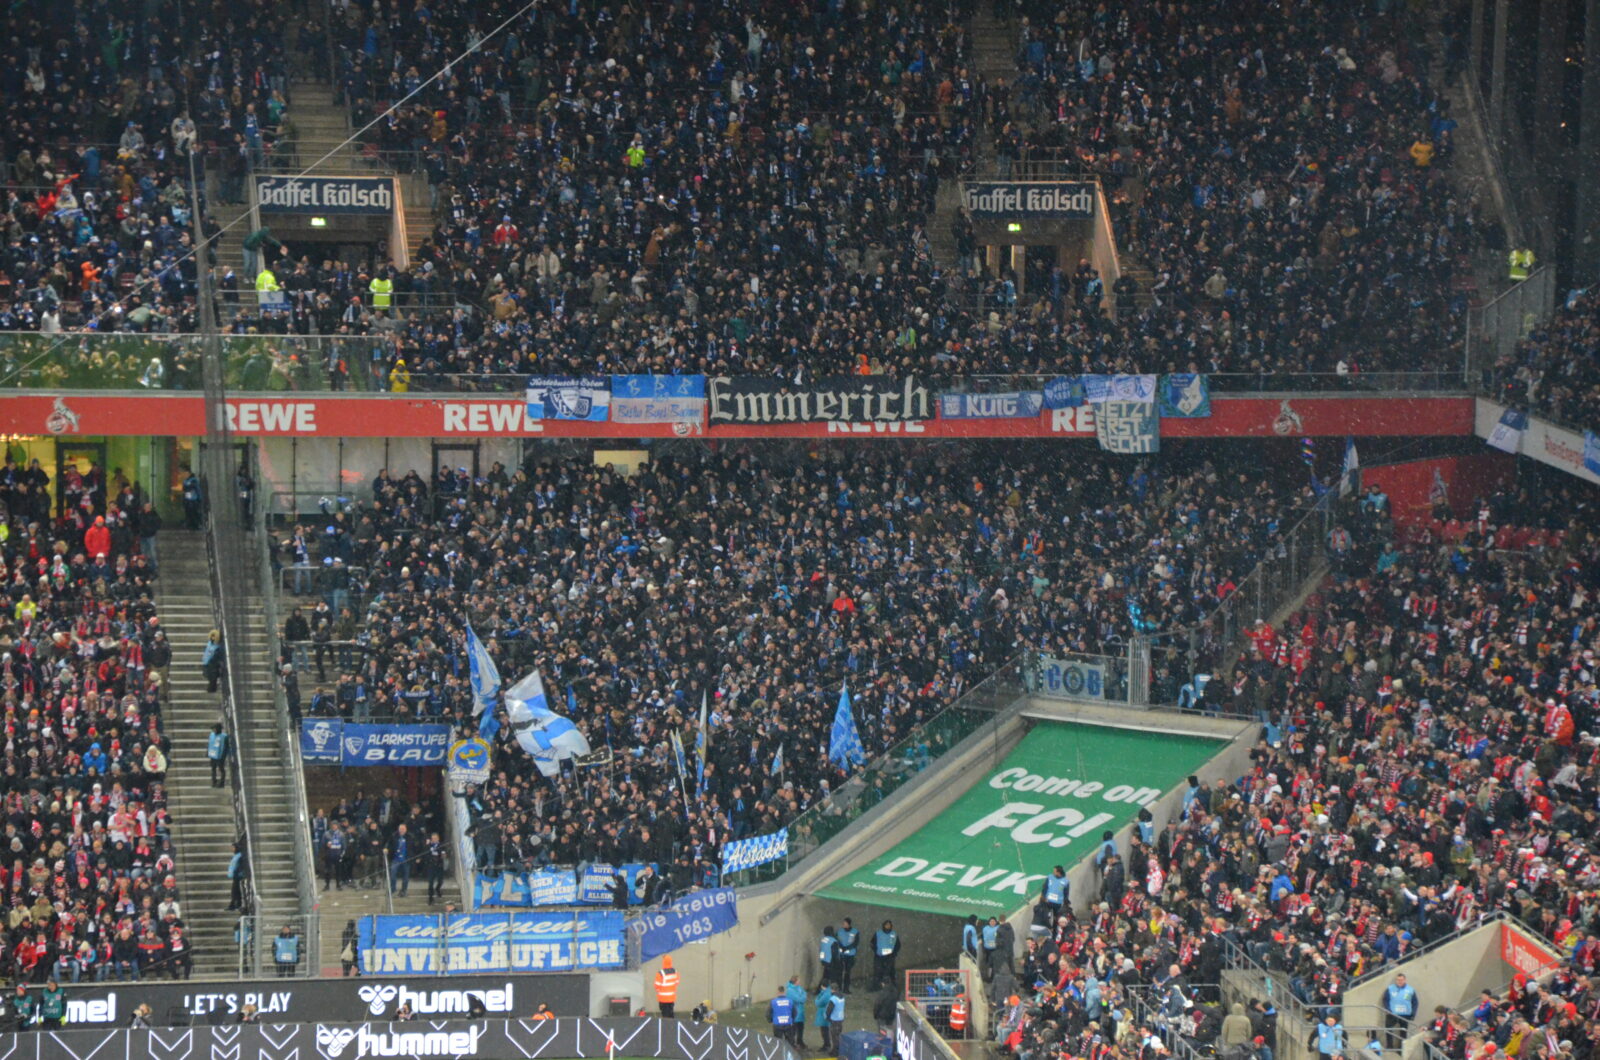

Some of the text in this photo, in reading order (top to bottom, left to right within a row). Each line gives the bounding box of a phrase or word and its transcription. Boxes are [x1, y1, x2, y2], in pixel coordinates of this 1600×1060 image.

[258, 179, 391, 210] Gaffel Kölsch
[966, 188, 1092, 214] Gaffel Kölsch
[709, 375, 929, 422] Emmerich
[216, 403, 317, 431] REWE
[1052, 404, 1096, 432] RE
[364, 748, 445, 761] BLAU
[368, 733, 446, 746] ALARMSTUFE
[989, 767, 1104, 798] Come
[961, 802, 1115, 848] FC!
[874, 856, 1047, 895] DEVK
[632, 891, 735, 936] Die Treuen
[673, 916, 713, 942] 1983
[362, 940, 620, 972] UNVERKÄUFLICH
[184, 992, 292, 1014] LET'S PLAY
[358, 1025, 478, 1056] hummel
